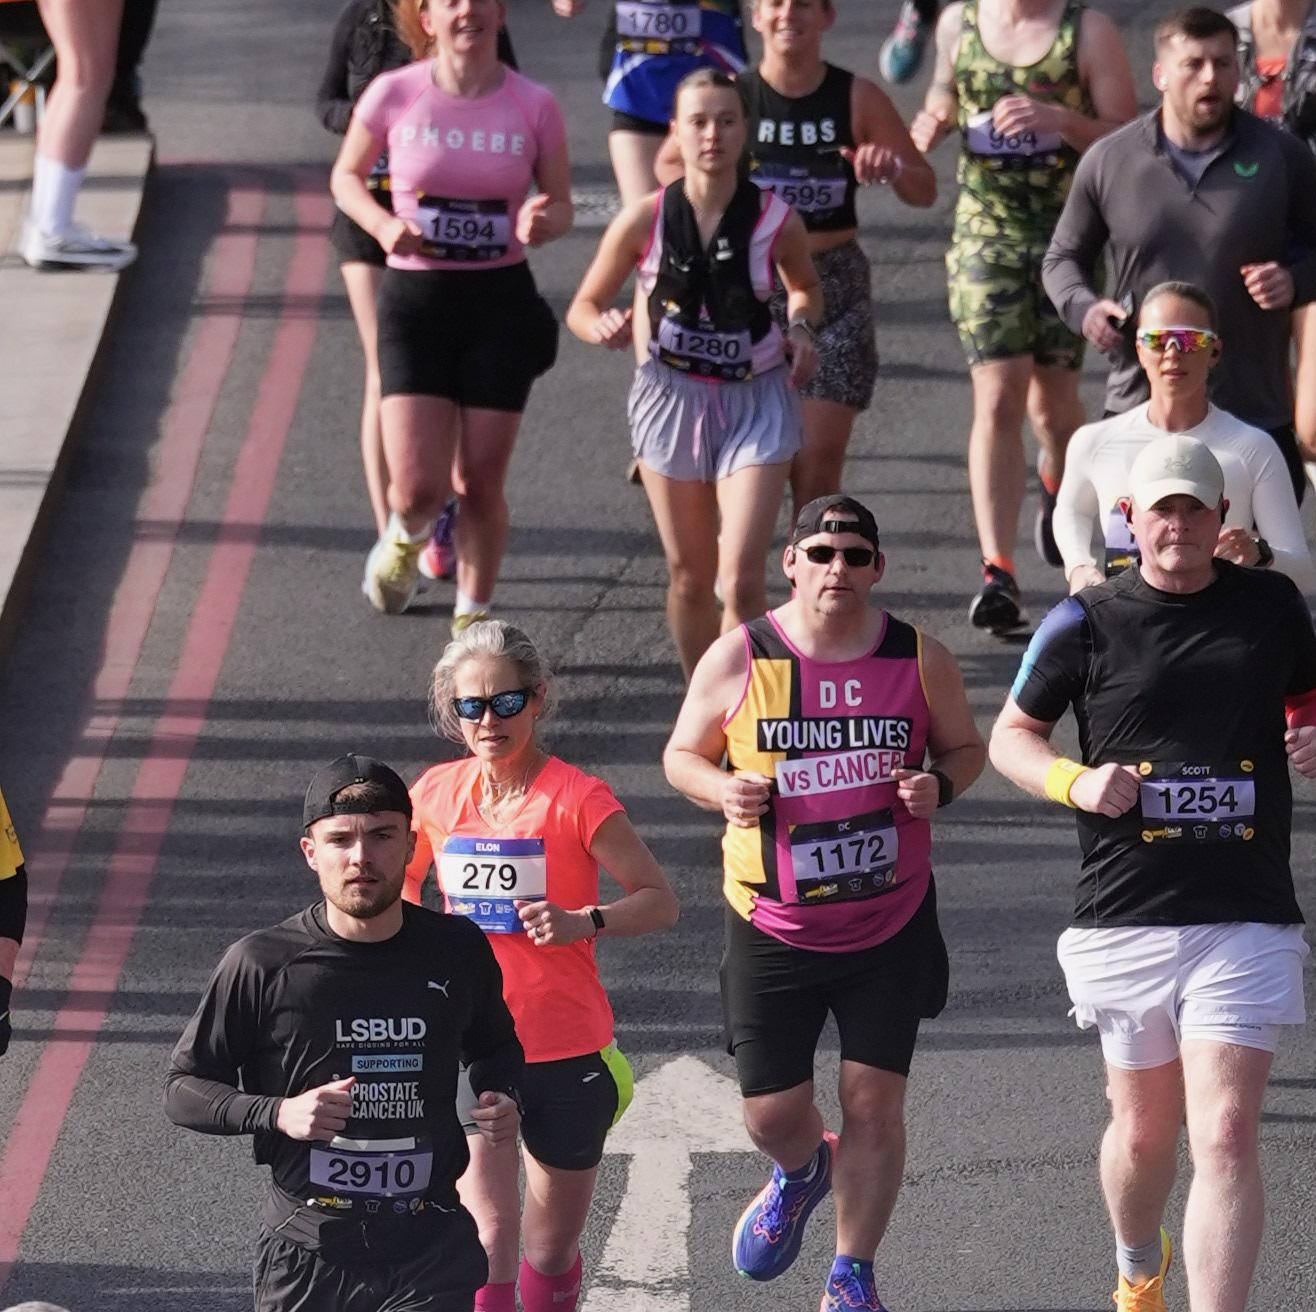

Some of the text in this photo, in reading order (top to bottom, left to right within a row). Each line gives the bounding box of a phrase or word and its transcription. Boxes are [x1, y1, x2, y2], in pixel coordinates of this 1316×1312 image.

[629, 12, 688, 34] 1780
[400, 126, 527, 155] PHOEBE
[758, 118, 836, 146] REBS
[430, 217, 496, 242] 1594
[673, 332, 740, 360] 1280
[761, 720, 910, 750] YOUNG LIVES
[1182, 766, 1211, 776] SCOTT
[1158, 785, 1239, 814] 1254
[838, 821, 851, 832] DC
[475, 842, 500, 852] ELON
[810, 835, 887, 872] 1172
[462, 863, 517, 891] 279
[335, 1017, 427, 1043] LSBUD
[357, 1058, 419, 1069] SUPPORTING
[350, 1081, 420, 1101] PROSTATE
[350, 1099, 425, 1120] CANCER UK
[327, 1158, 416, 1188] 2910
